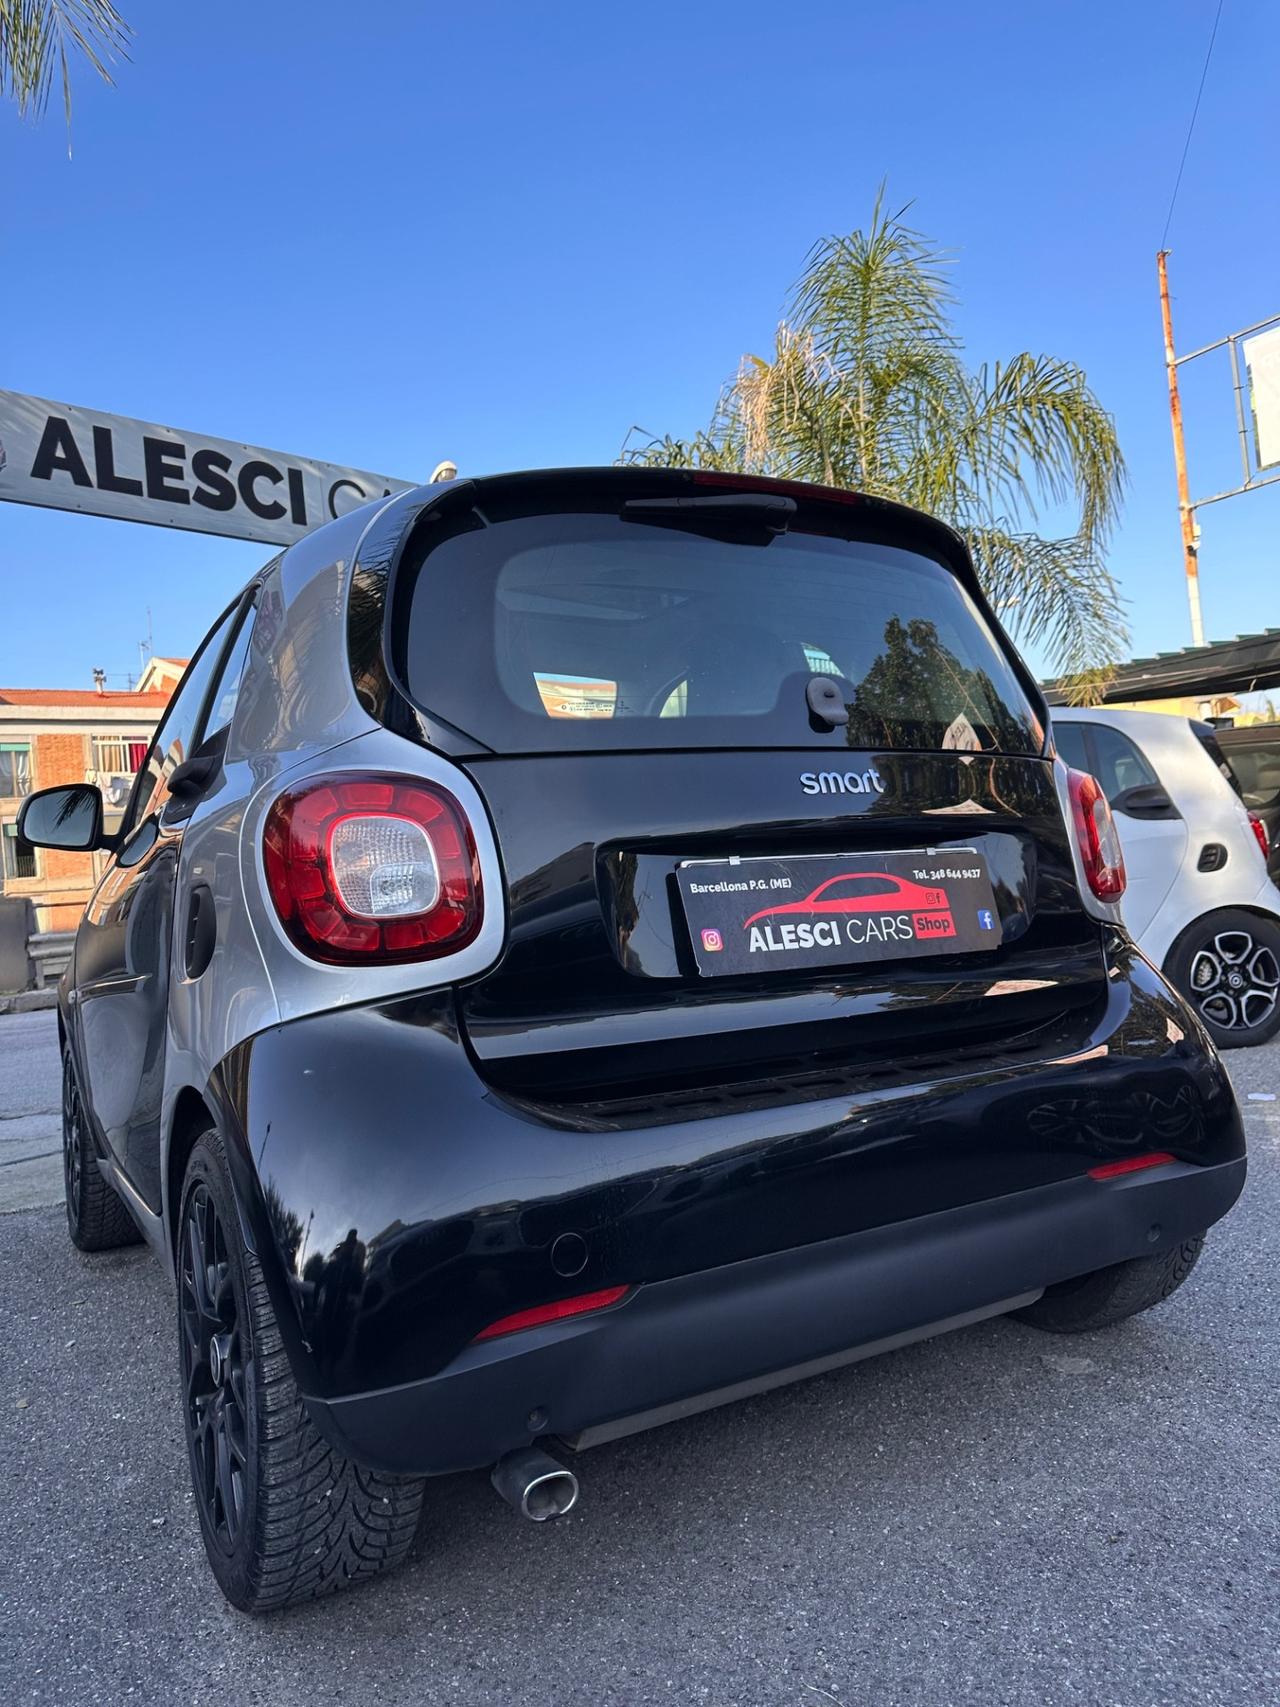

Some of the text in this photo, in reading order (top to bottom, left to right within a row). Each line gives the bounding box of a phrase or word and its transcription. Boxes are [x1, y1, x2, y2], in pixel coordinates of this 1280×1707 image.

[30, 415, 308, 526] ALESCI
[800, 768, 884, 795] smart
[689, 877, 792, 894] Barcellona P.G. (ME)
[930, 869, 946, 881] 348
[946, 868, 962, 880] 644
[962, 868, 981, 879] 9437
[749, 914, 951, 953] ALESCI CARS Shop
